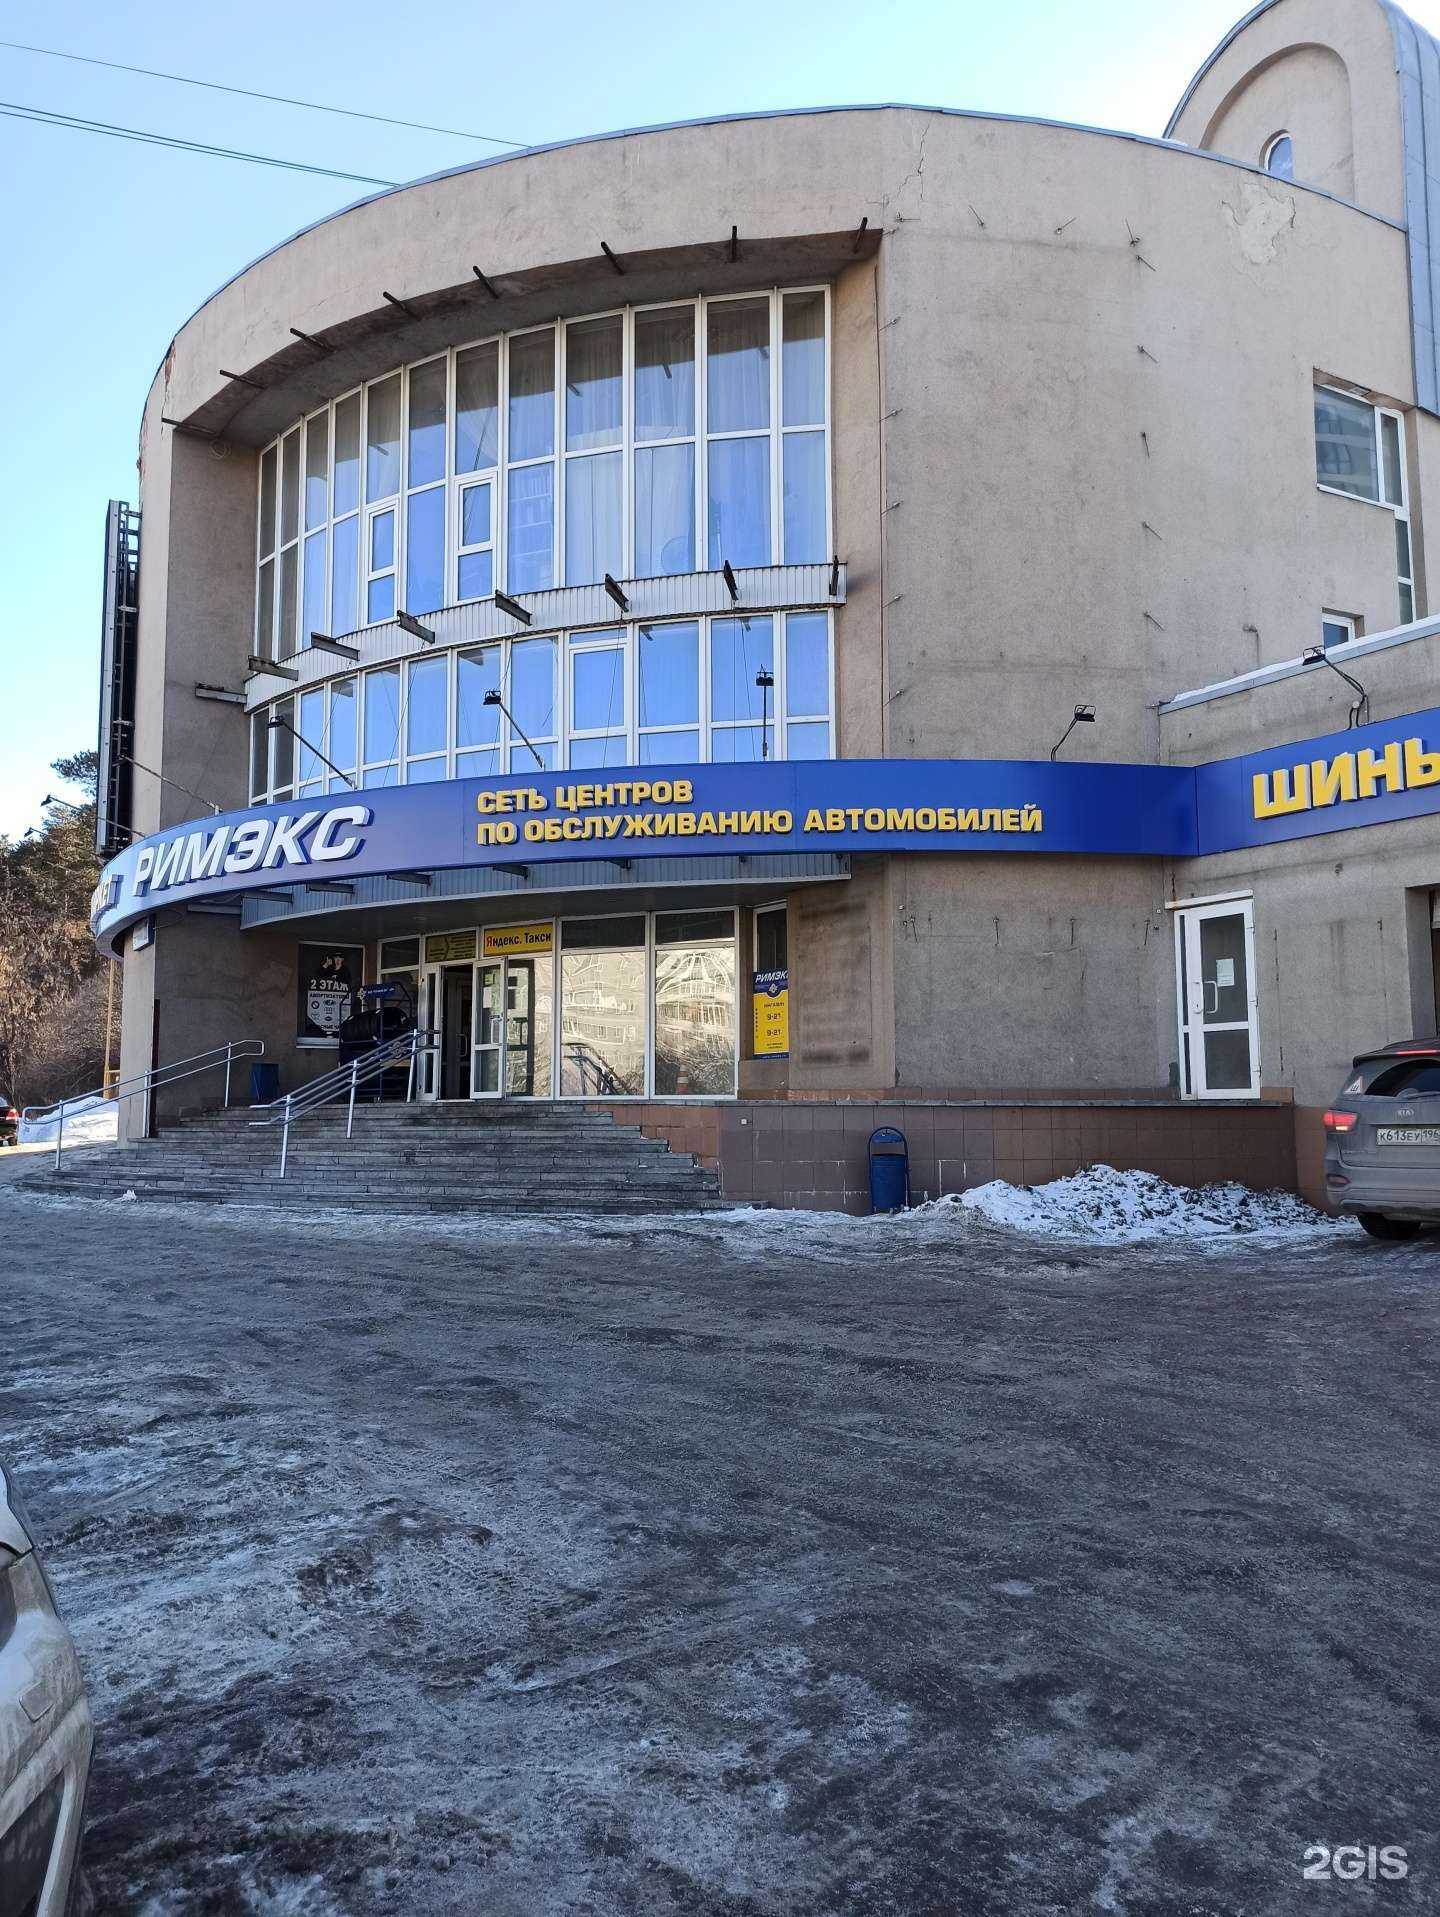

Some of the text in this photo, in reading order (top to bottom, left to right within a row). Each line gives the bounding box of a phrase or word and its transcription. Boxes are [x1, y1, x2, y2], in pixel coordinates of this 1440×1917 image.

[477, 780, 693, 814] СЕТЬ ЦЕНТРОВ
[477, 803, 1043, 846] ПО ОБСЛУЖИВАНИЮ АВТОМОБИЛЕЙ
[134, 806, 372, 896] РИМЭКС
[525, 932, 551, 943] Такси
[310, 979, 349, 991] 2 ЭТАЖ
[755, 970, 788, 983] РИМЭК
